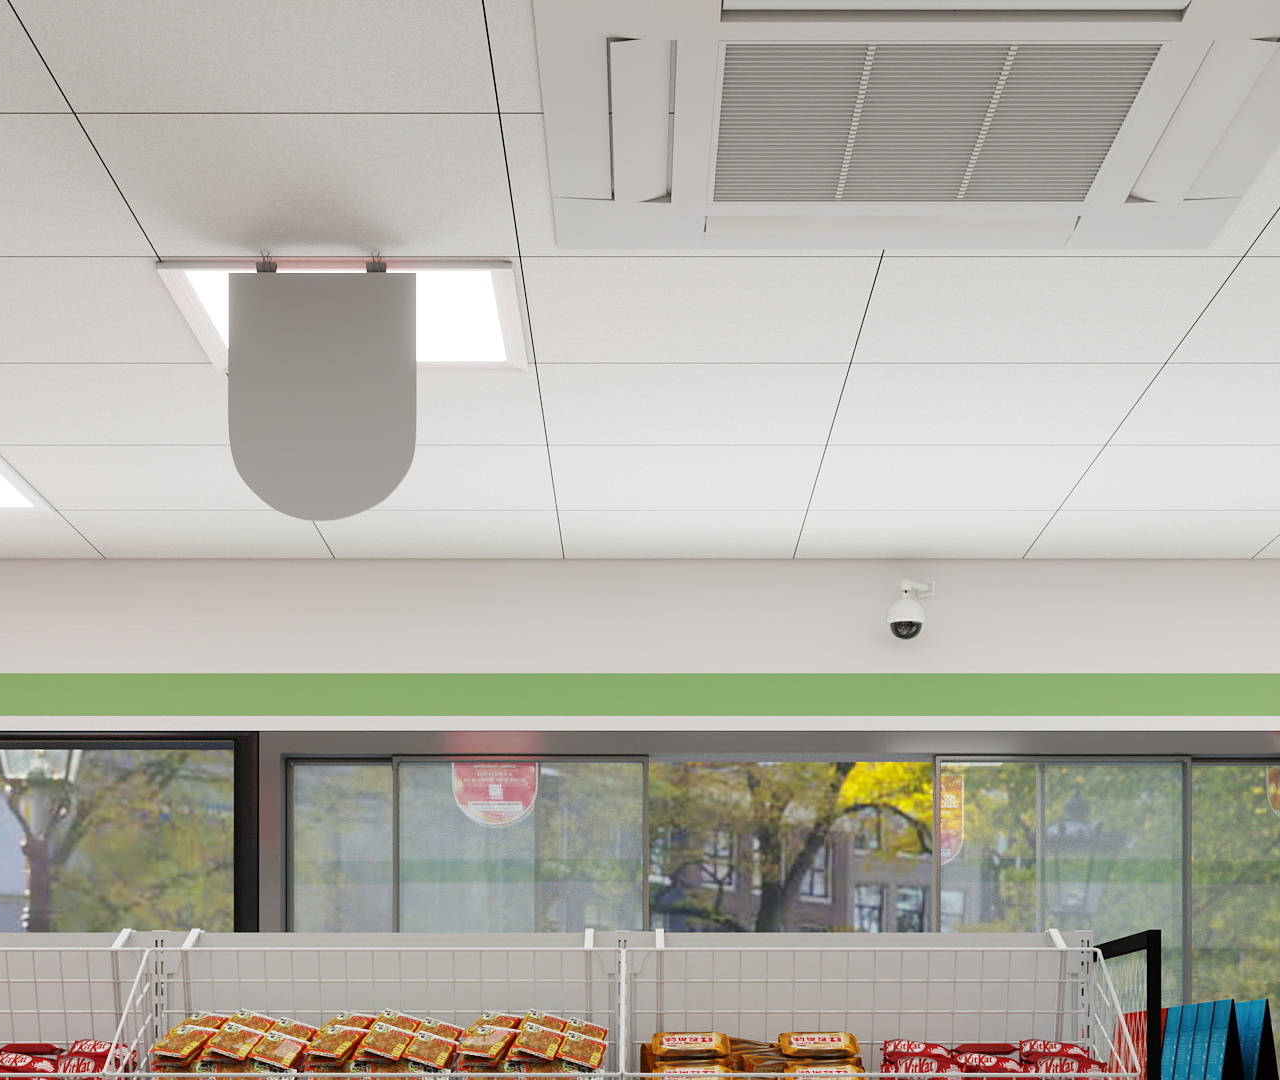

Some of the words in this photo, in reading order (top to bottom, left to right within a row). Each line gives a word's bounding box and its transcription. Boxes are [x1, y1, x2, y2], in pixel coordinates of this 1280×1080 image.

[74, 1040, 107, 1052] KitKat
[892, 1040, 922, 1052] KitKat
[1028, 1041, 1058, 1052] KitKat
[59, 1056, 92, 1074] KitKat
[964, 1054, 994, 1065] KitKat
[903, 1058, 934, 1074] KitKat
[1043, 1058, 1074, 1074] KitKat
